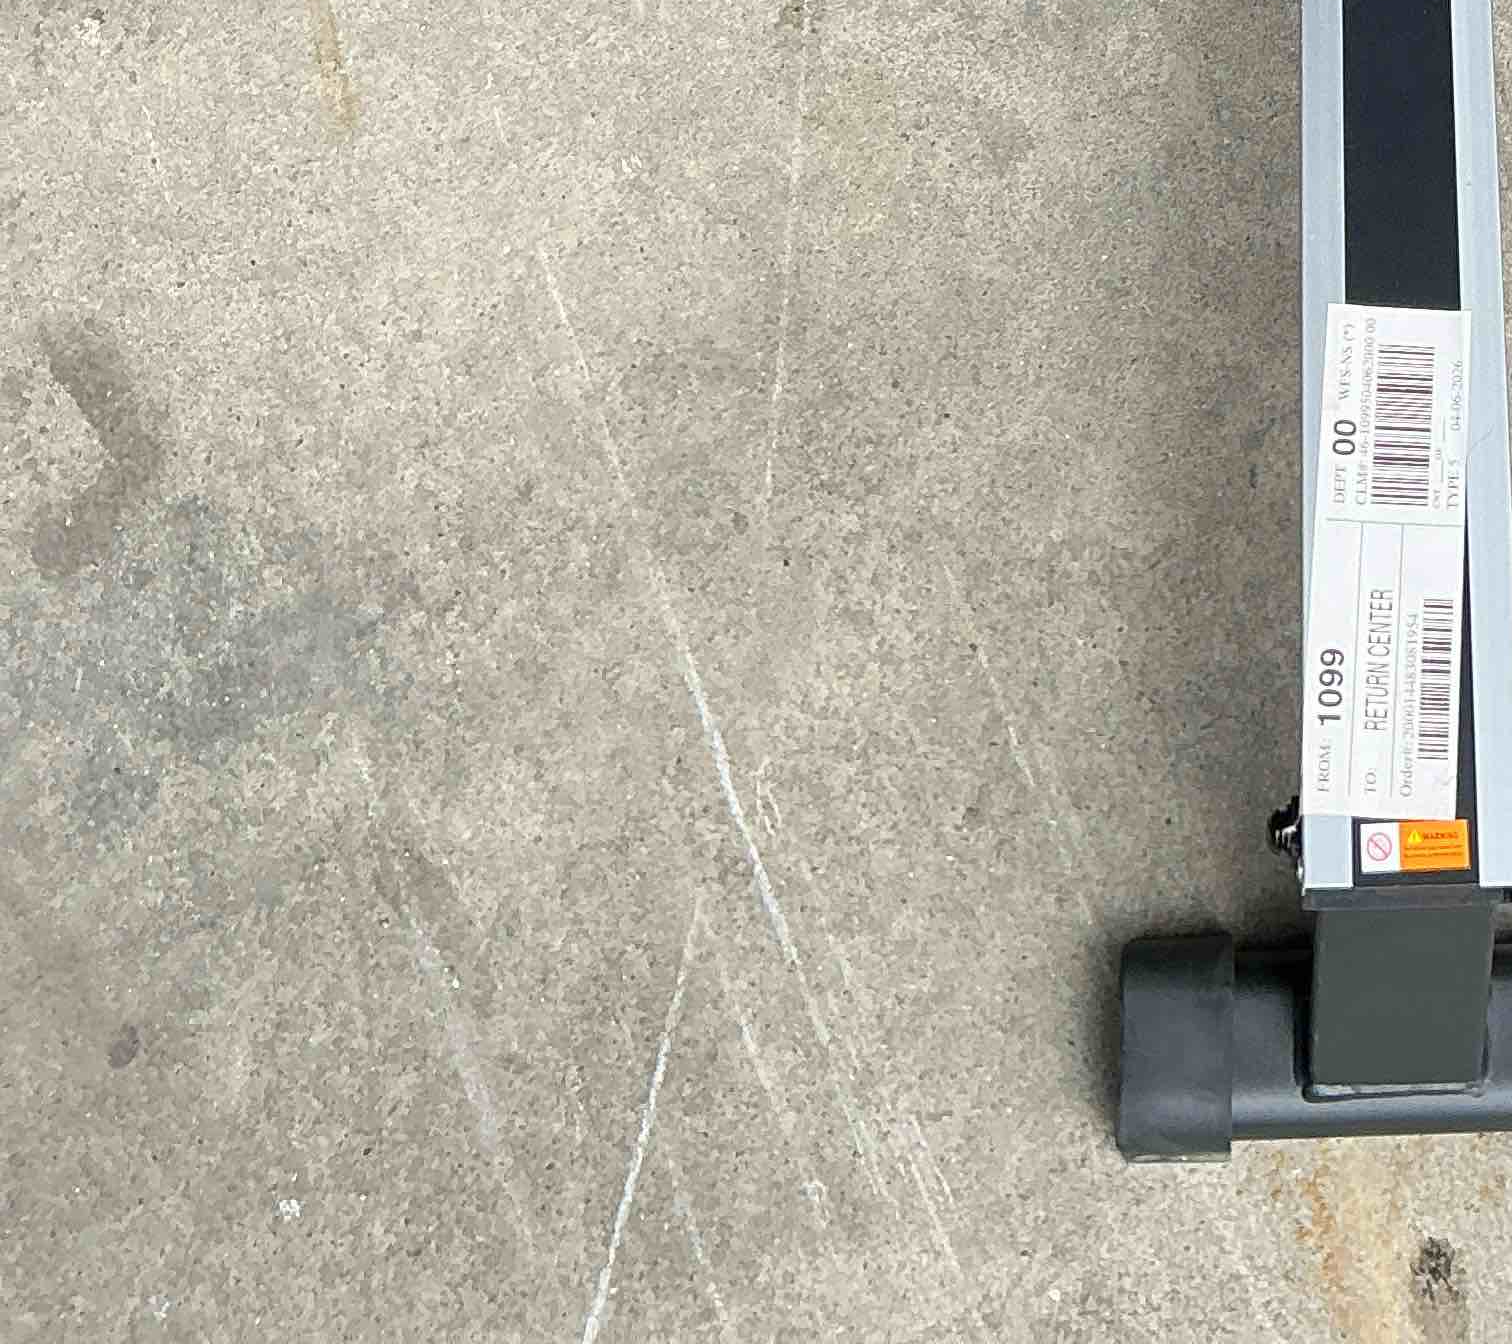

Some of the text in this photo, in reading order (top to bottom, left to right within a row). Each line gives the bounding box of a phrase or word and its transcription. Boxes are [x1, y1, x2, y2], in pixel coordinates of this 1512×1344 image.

[1332, 419, 1356, 456] 00
[1333, 464, 1347, 504] DEPT
[1317, 648, 1345, 793] FROM: 1099
[1363, 589, 1393, 795] TO: RETURN CENTER
